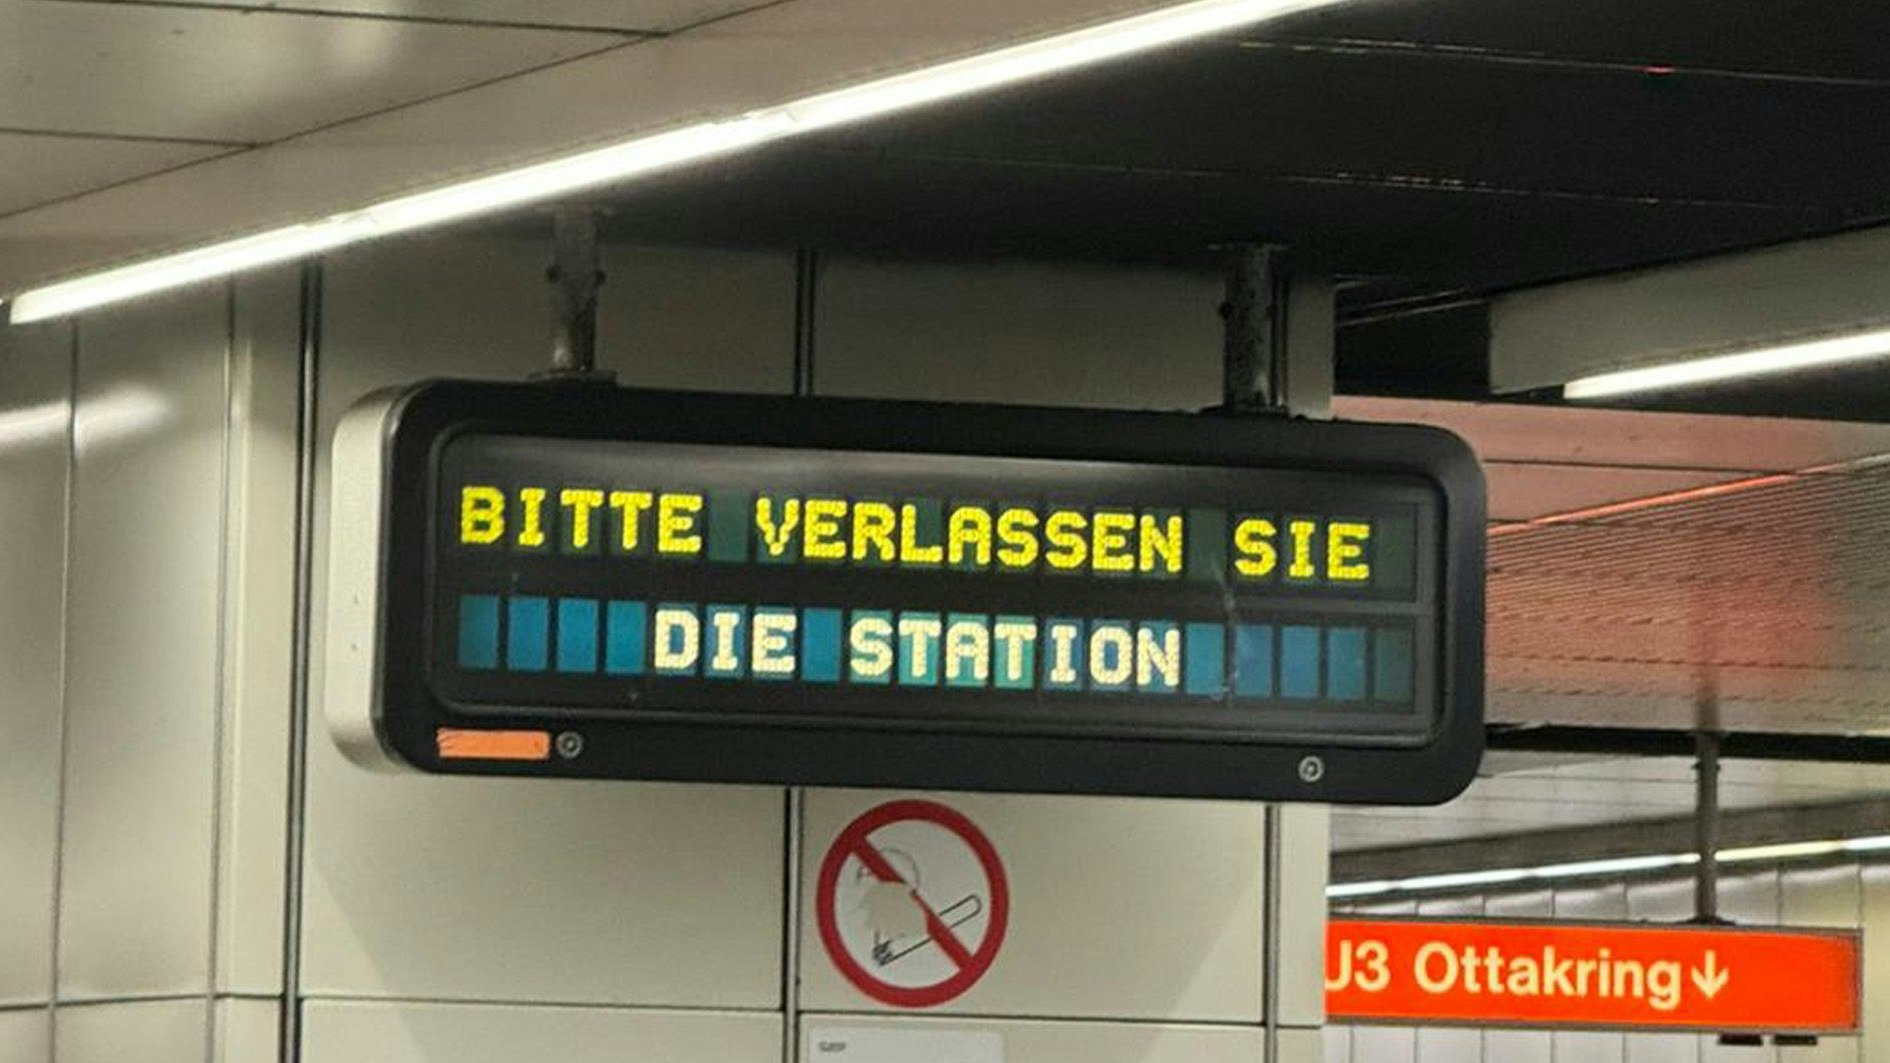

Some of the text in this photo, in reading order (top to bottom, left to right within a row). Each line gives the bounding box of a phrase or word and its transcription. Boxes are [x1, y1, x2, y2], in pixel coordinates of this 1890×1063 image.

[461, 486, 1371, 580] BITTE VERLASSEN SIE
[654, 608, 1182, 687] DIE STATION
[1414, 942, 1682, 1011] Ottakring
